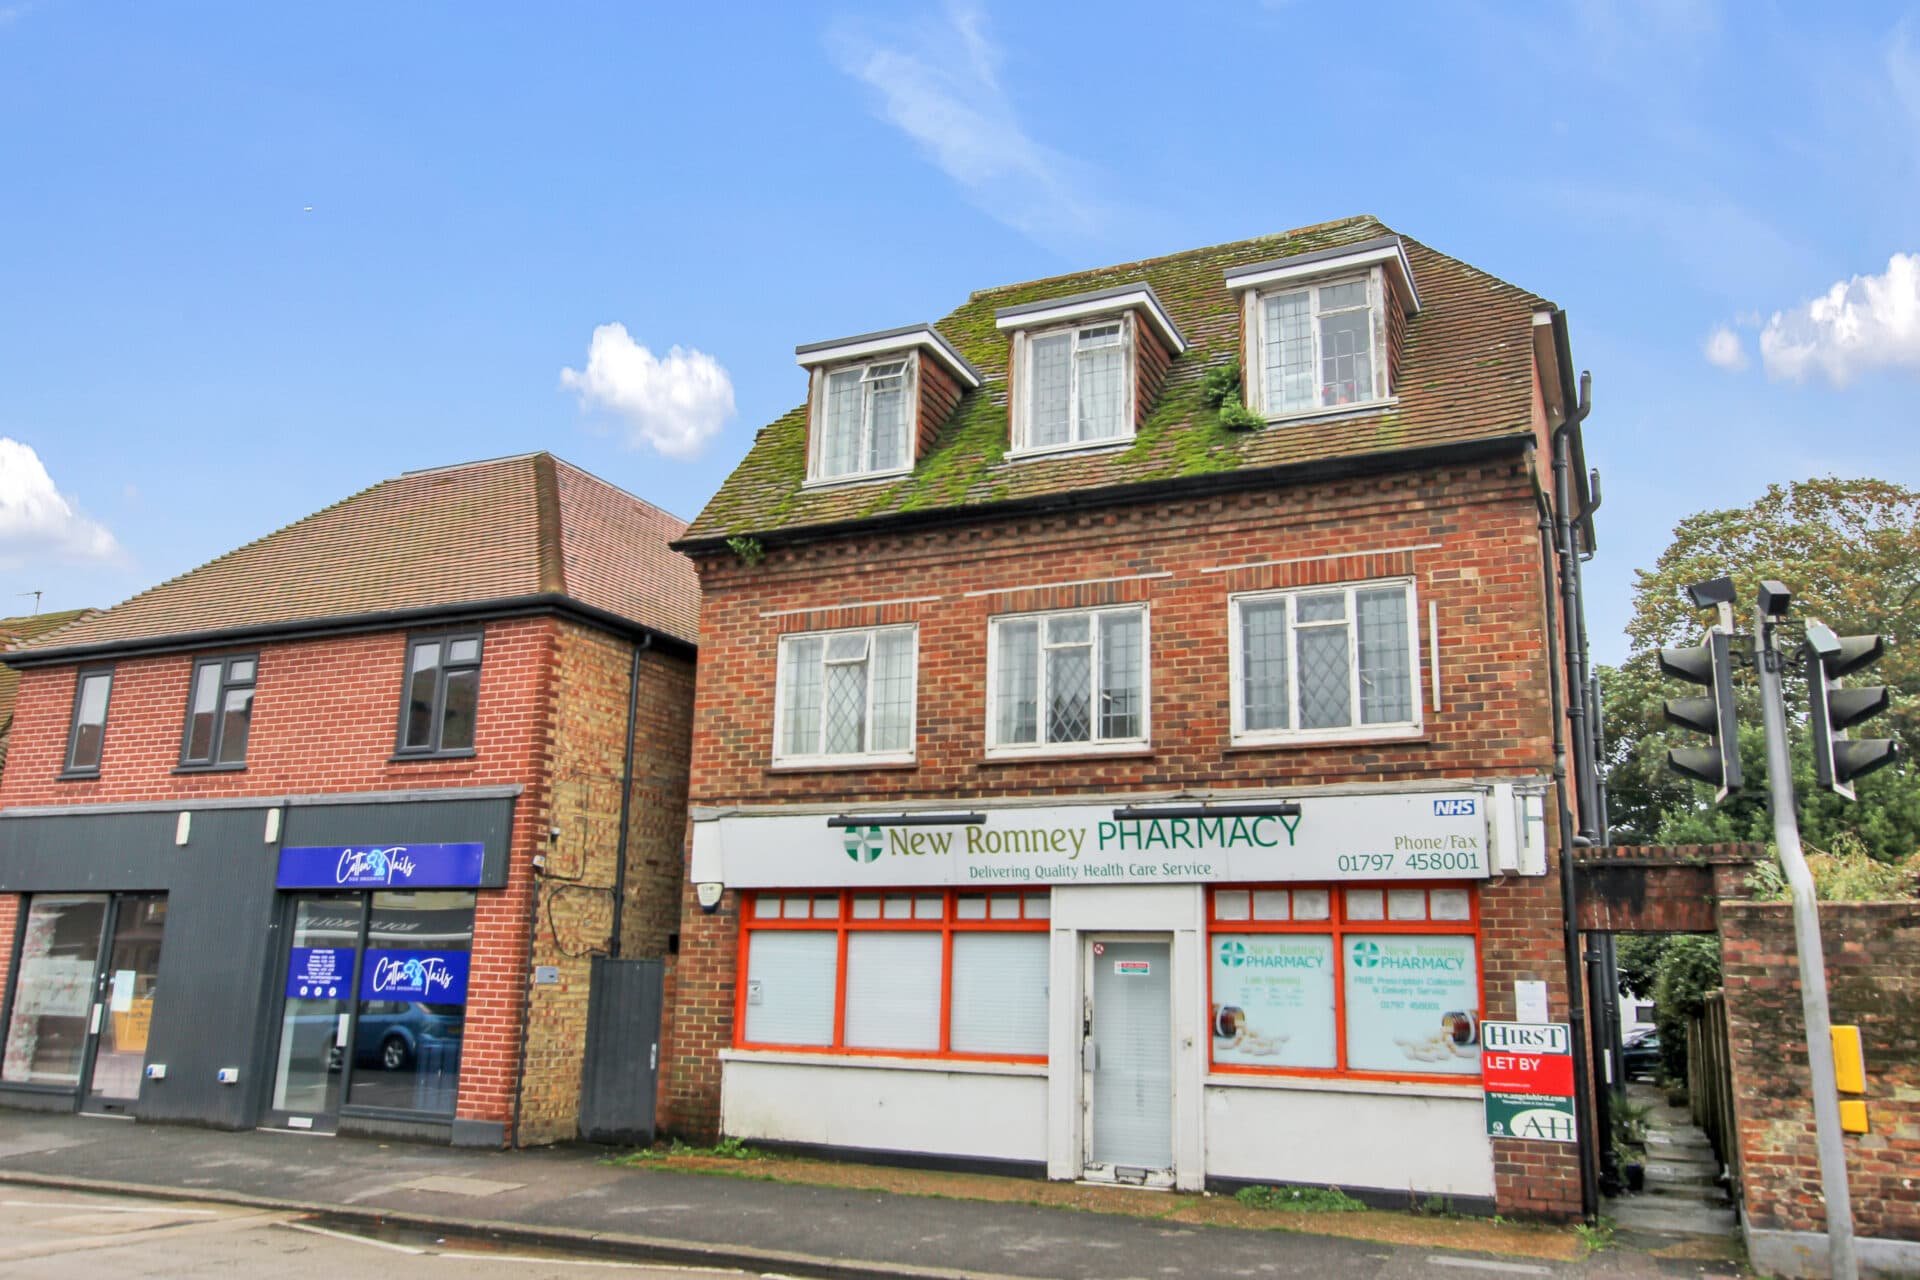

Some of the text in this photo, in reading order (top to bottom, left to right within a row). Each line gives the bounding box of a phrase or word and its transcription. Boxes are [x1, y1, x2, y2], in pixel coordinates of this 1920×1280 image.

[1435, 800, 1474, 815] NHS
[889, 815, 1302, 860] New Romney PHARMACY
[1394, 835, 1478, 850] Phone/Fax
[336, 847, 416, 885] Cotton Tails
[969, 862, 1212, 880] Delivering Quality Health Care Service
[1338, 852, 1480, 872] 01797 458001
[1246, 956, 1324, 968] PHARMACY
[1381, 956, 1464, 970] PHARMACY
[373, 957, 408, 992] Cotton
[420, 957, 454, 996] Tails
[1490, 1026, 1562, 1048] HIRST
[1487, 1056, 1540, 1072] LET BY
[1523, 1116, 1574, 1140] AH
